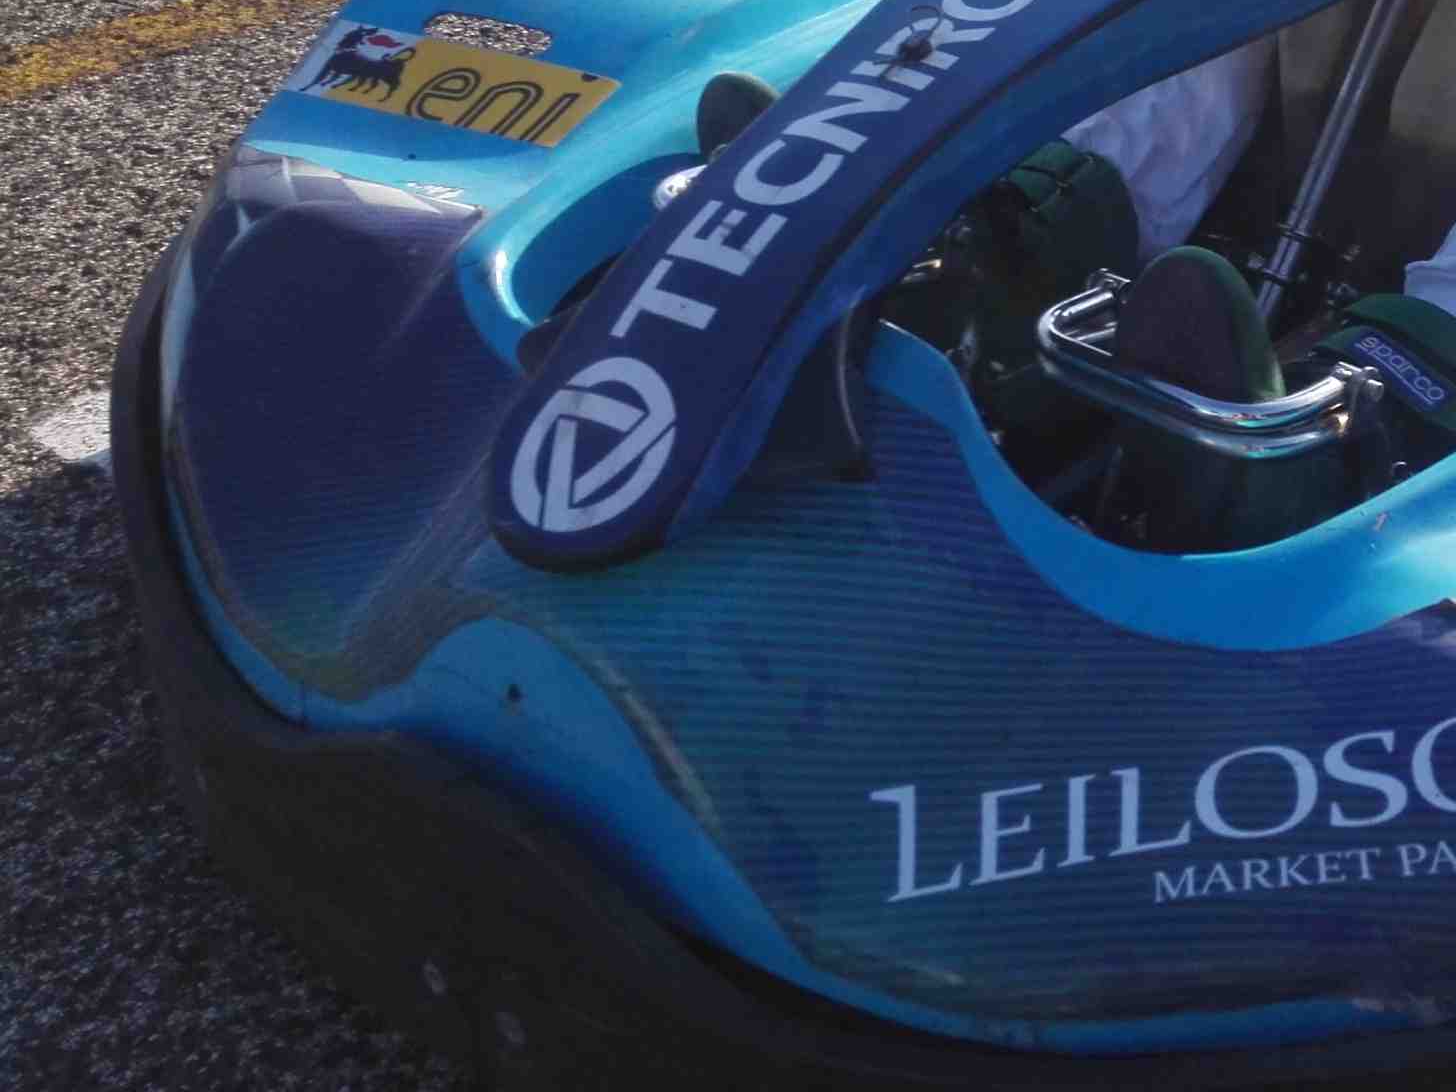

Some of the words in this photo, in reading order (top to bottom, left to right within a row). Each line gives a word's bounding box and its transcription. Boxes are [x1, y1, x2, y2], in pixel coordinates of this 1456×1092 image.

[407, 67, 598, 141] eni
[1355, 336, 1446, 402] sparco
[1152, 847, 1381, 904] MARKET
